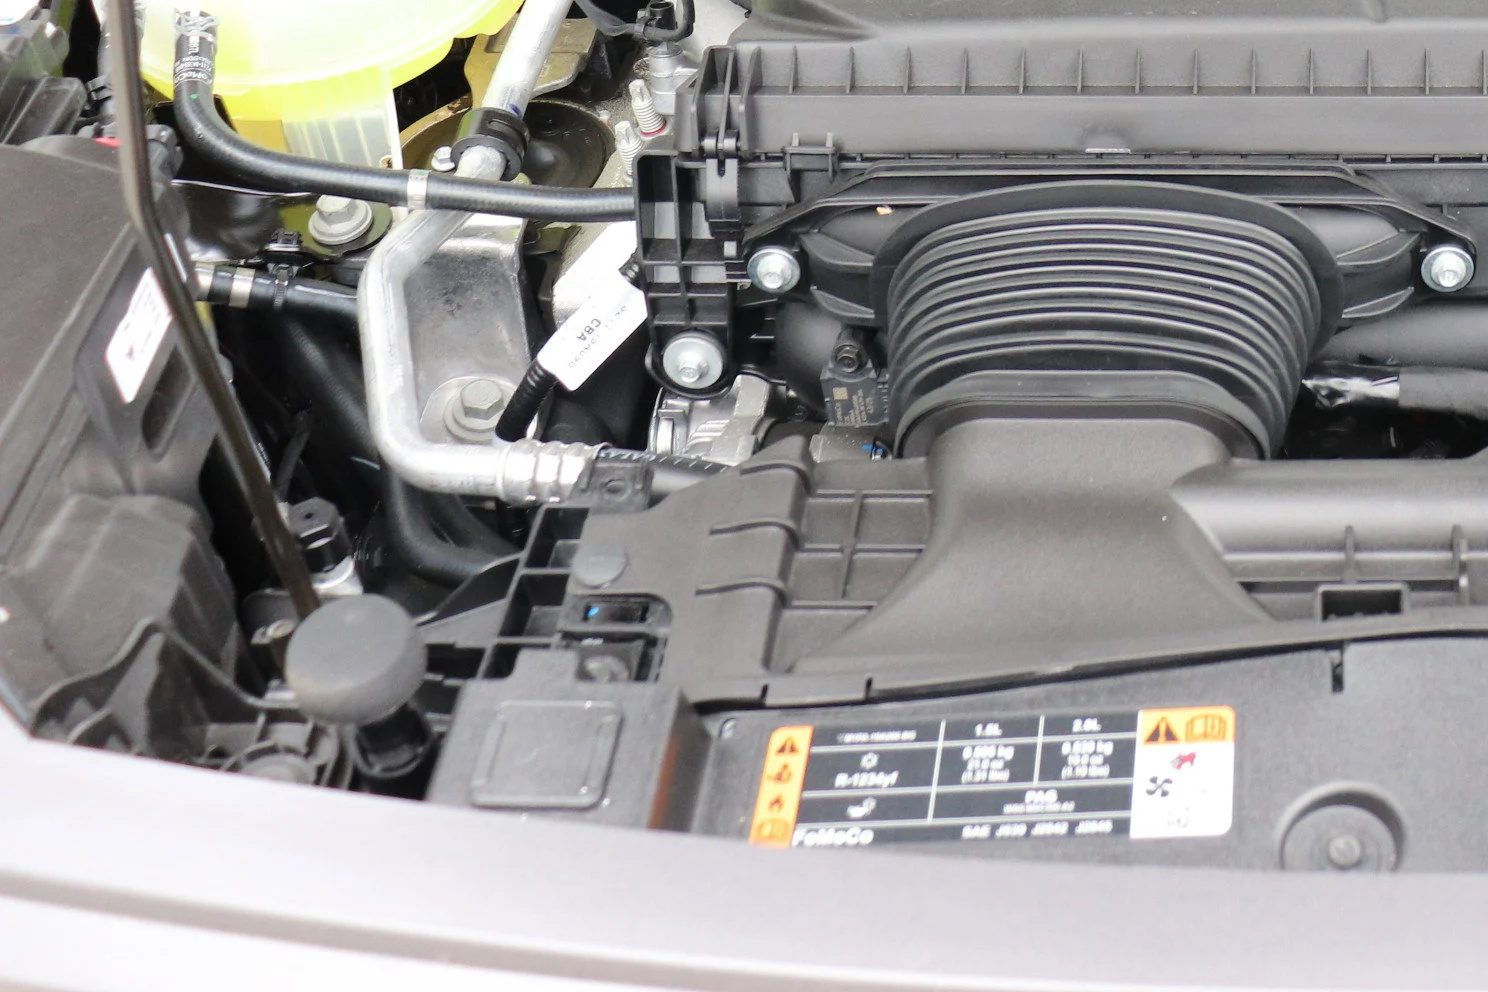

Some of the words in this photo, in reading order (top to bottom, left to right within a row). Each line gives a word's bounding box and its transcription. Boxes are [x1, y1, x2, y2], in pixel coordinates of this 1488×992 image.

[576, 318, 602, 341] CBA
[997, 744, 1015, 761] kg
[1096, 739, 1114, 756] kg
[833, 770, 899, 788] R-1234yf
[1024, 789, 1058, 804] PAG
[791, 826, 875, 848] FoMoCo
